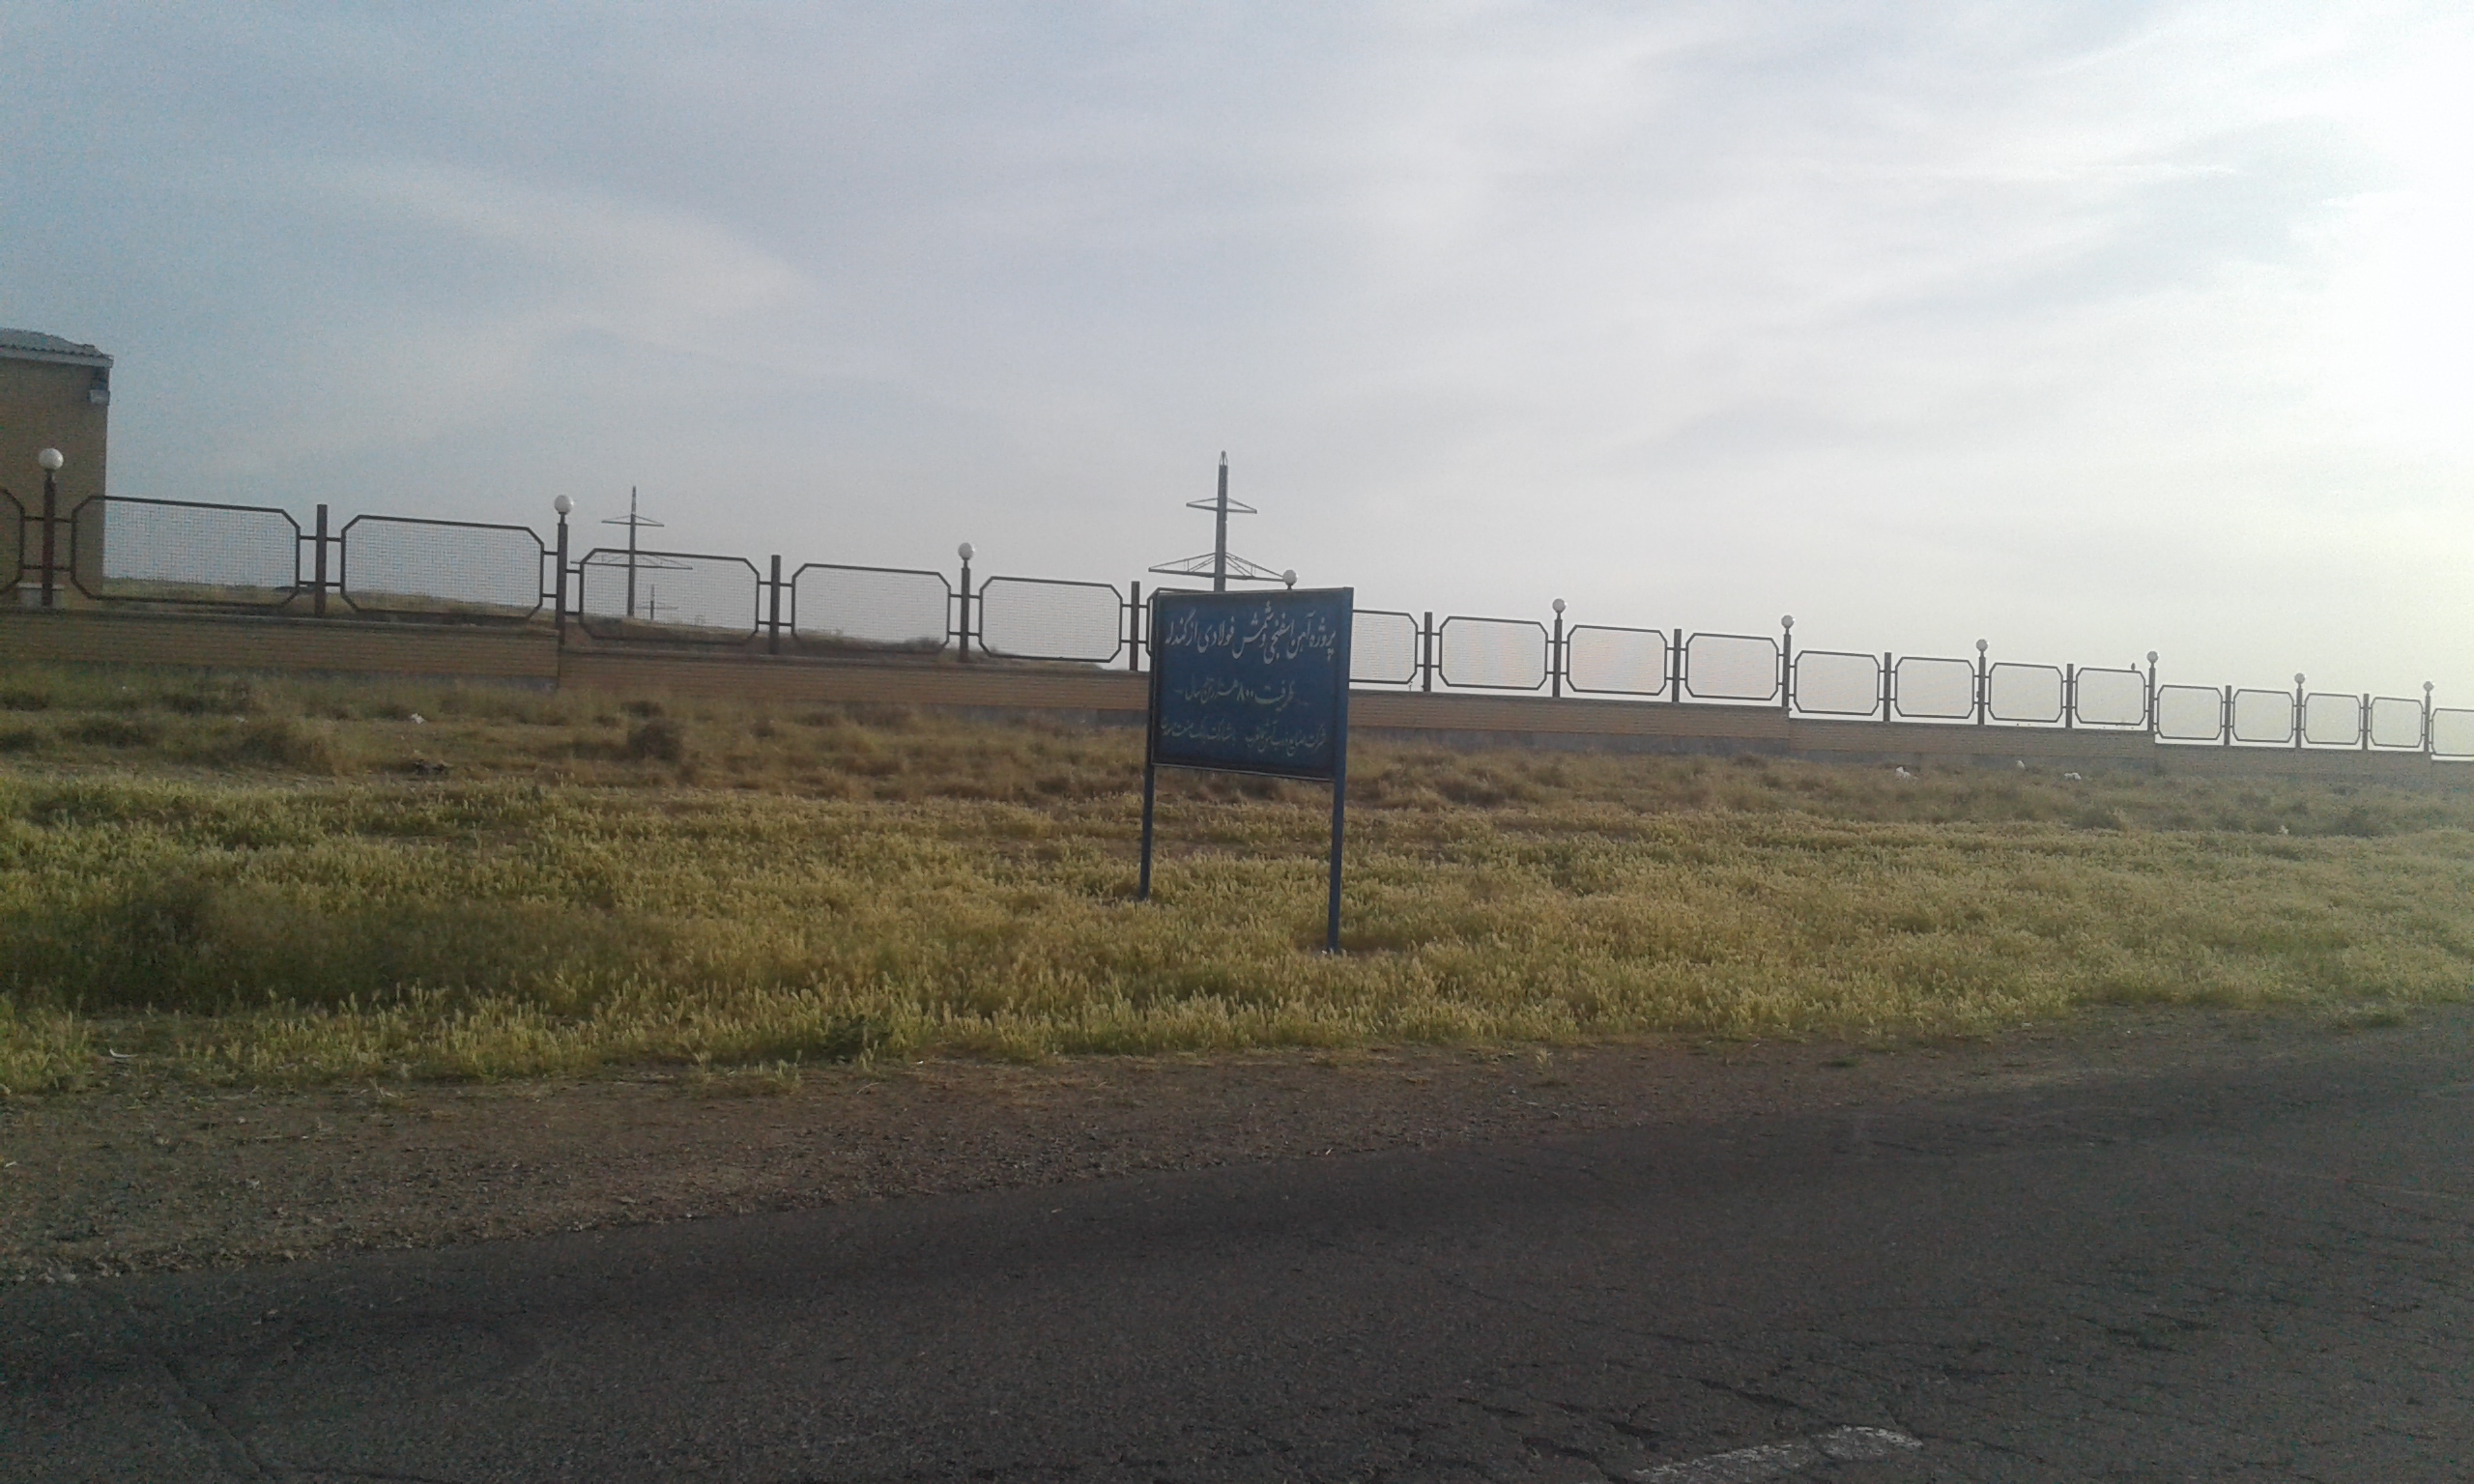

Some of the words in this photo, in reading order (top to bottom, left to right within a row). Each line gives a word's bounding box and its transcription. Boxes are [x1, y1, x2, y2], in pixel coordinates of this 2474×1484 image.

[1196, 615, 1235, 654] فولادی
[1286, 610, 1316, 659] آهن
[1309, 616, 1337, 661] پروژه
